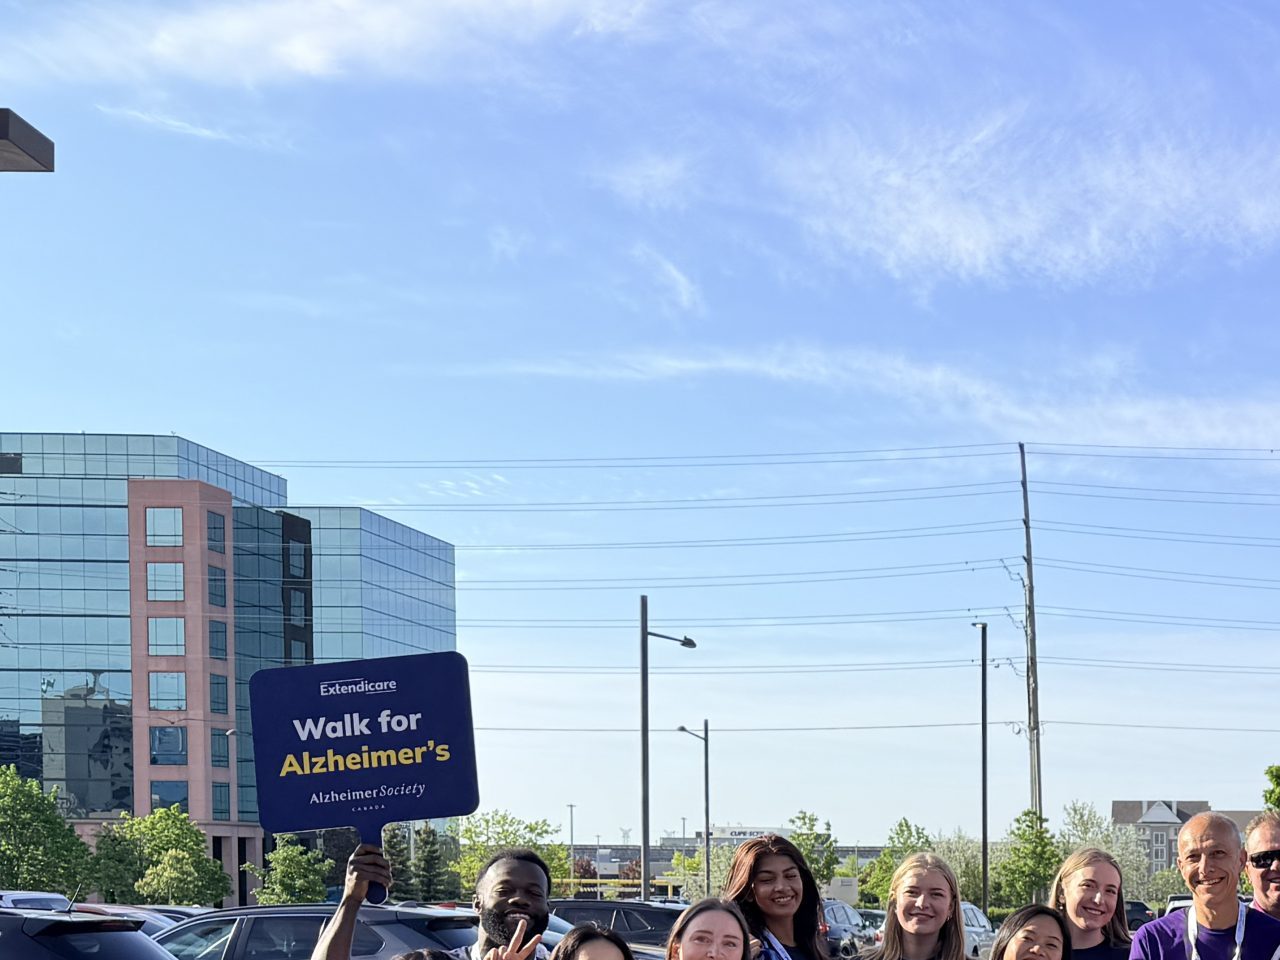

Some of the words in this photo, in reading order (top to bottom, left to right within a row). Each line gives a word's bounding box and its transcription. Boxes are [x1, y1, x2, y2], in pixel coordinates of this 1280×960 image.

[320, 680, 397, 696] Extendicare
[293, 713, 371, 741] Walk
[378, 710, 422, 733] for
[279, 740, 450, 777] Alzheimer's
